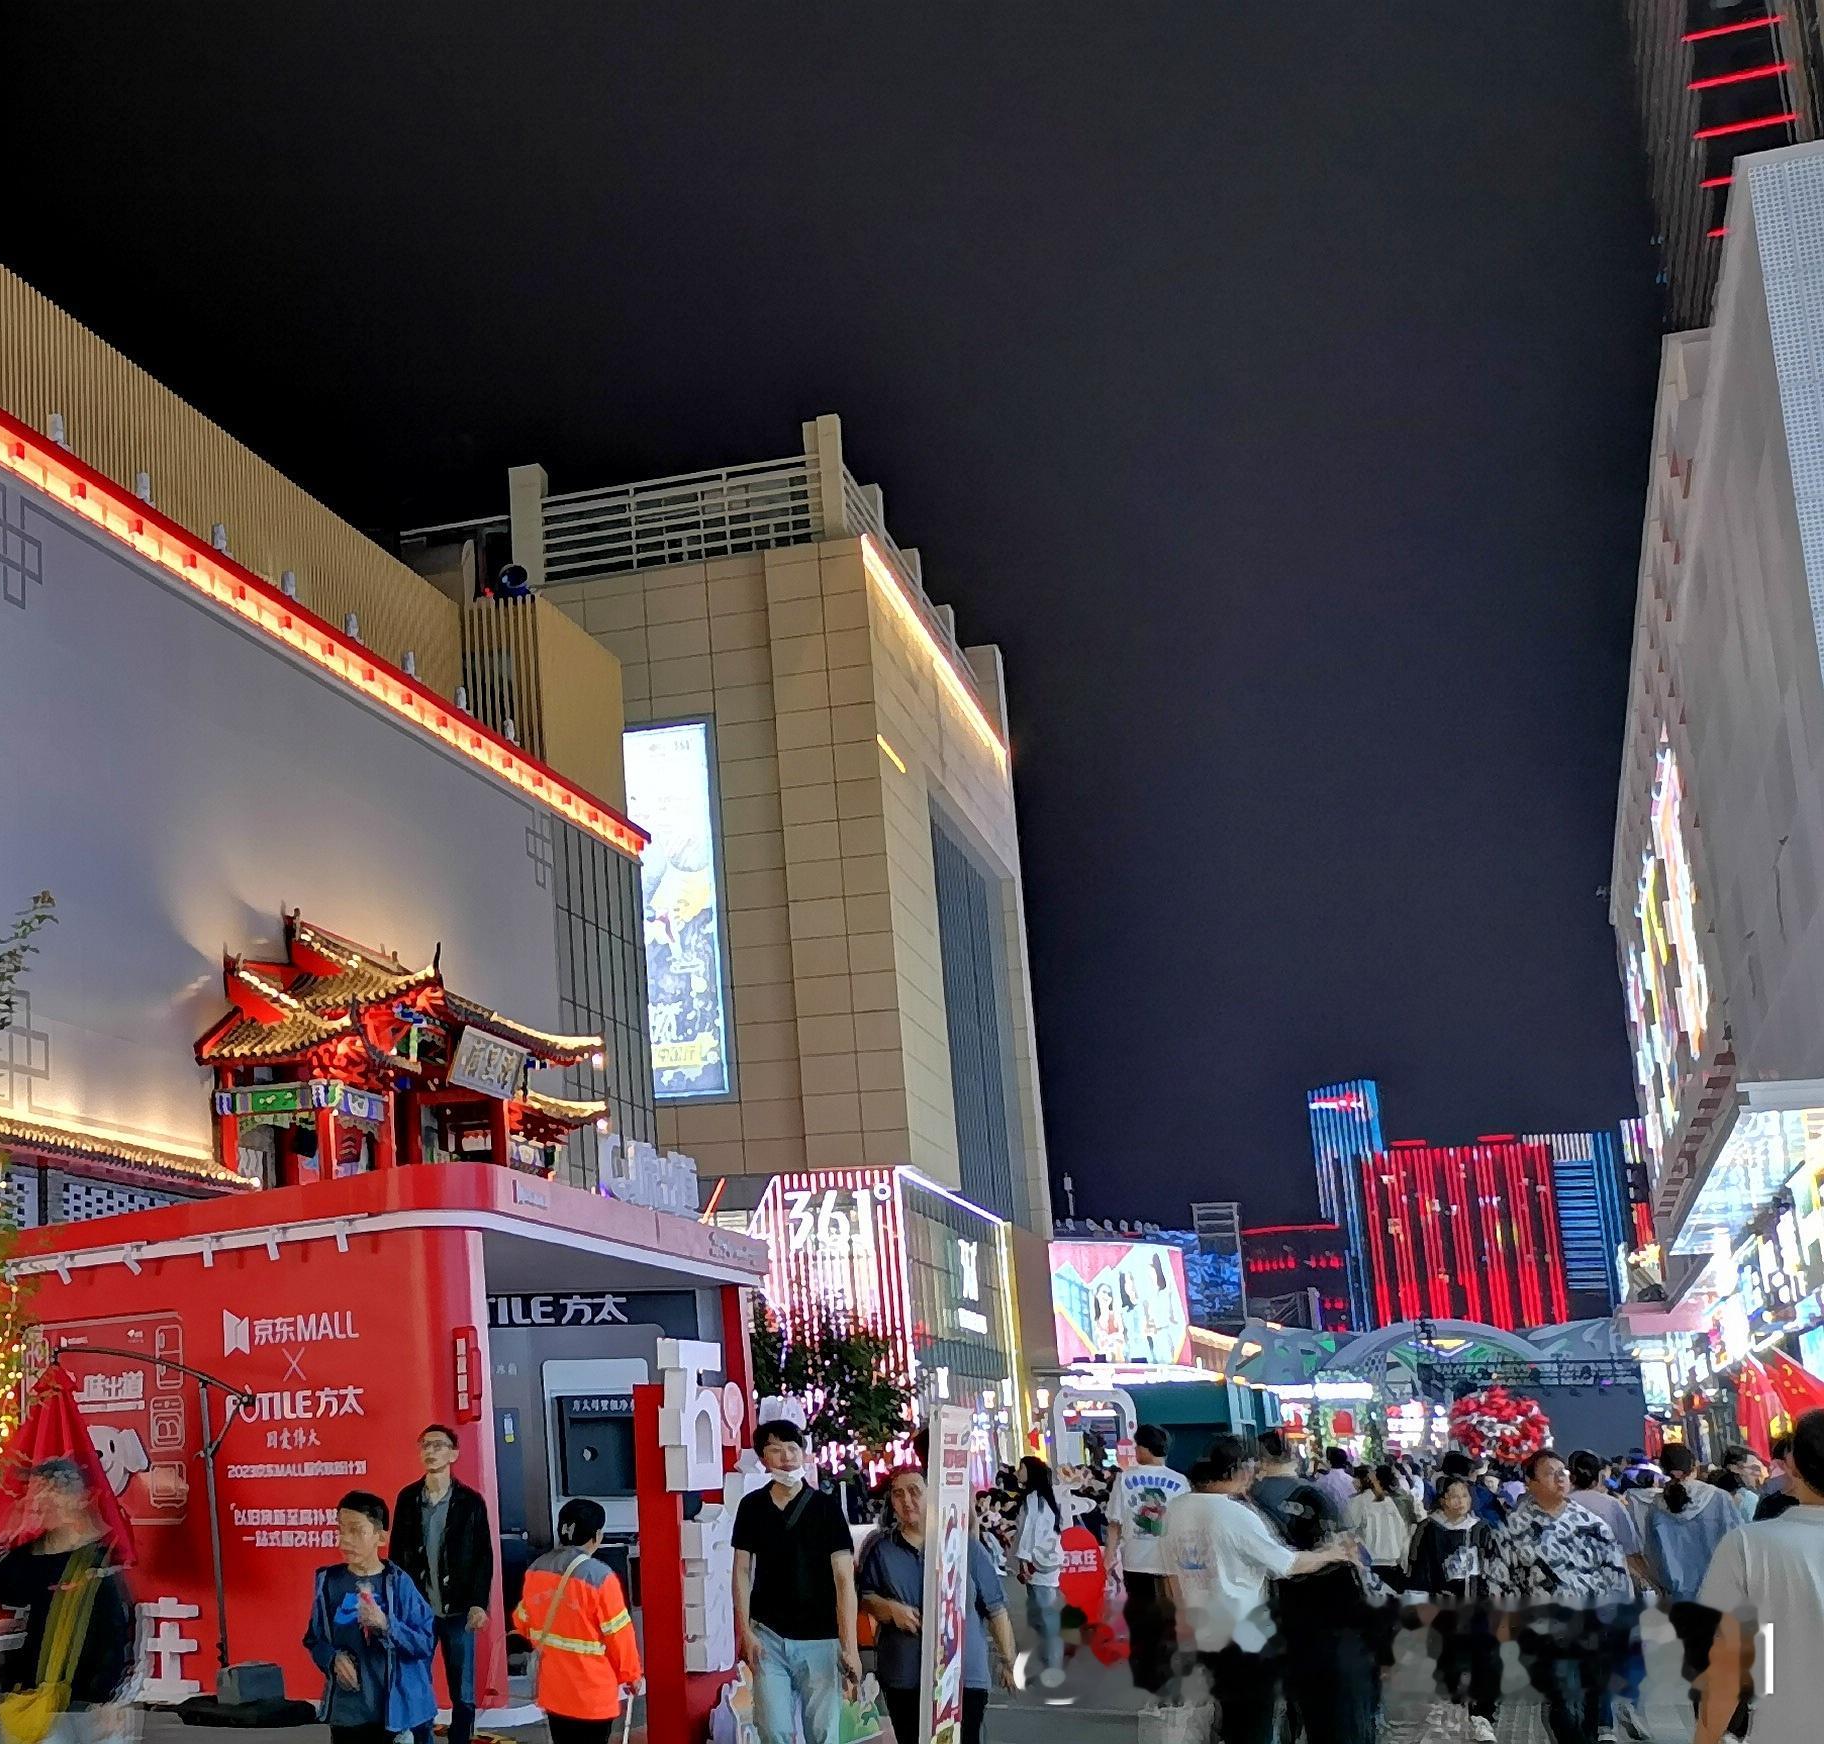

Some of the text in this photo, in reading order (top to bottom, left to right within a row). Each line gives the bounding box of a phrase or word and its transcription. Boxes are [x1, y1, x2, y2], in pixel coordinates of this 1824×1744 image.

[559, 1293, 629, 1325] 方太
[253, 1310, 360, 1346] 京东MALL
[314, 1385, 365, 1418] 方太
